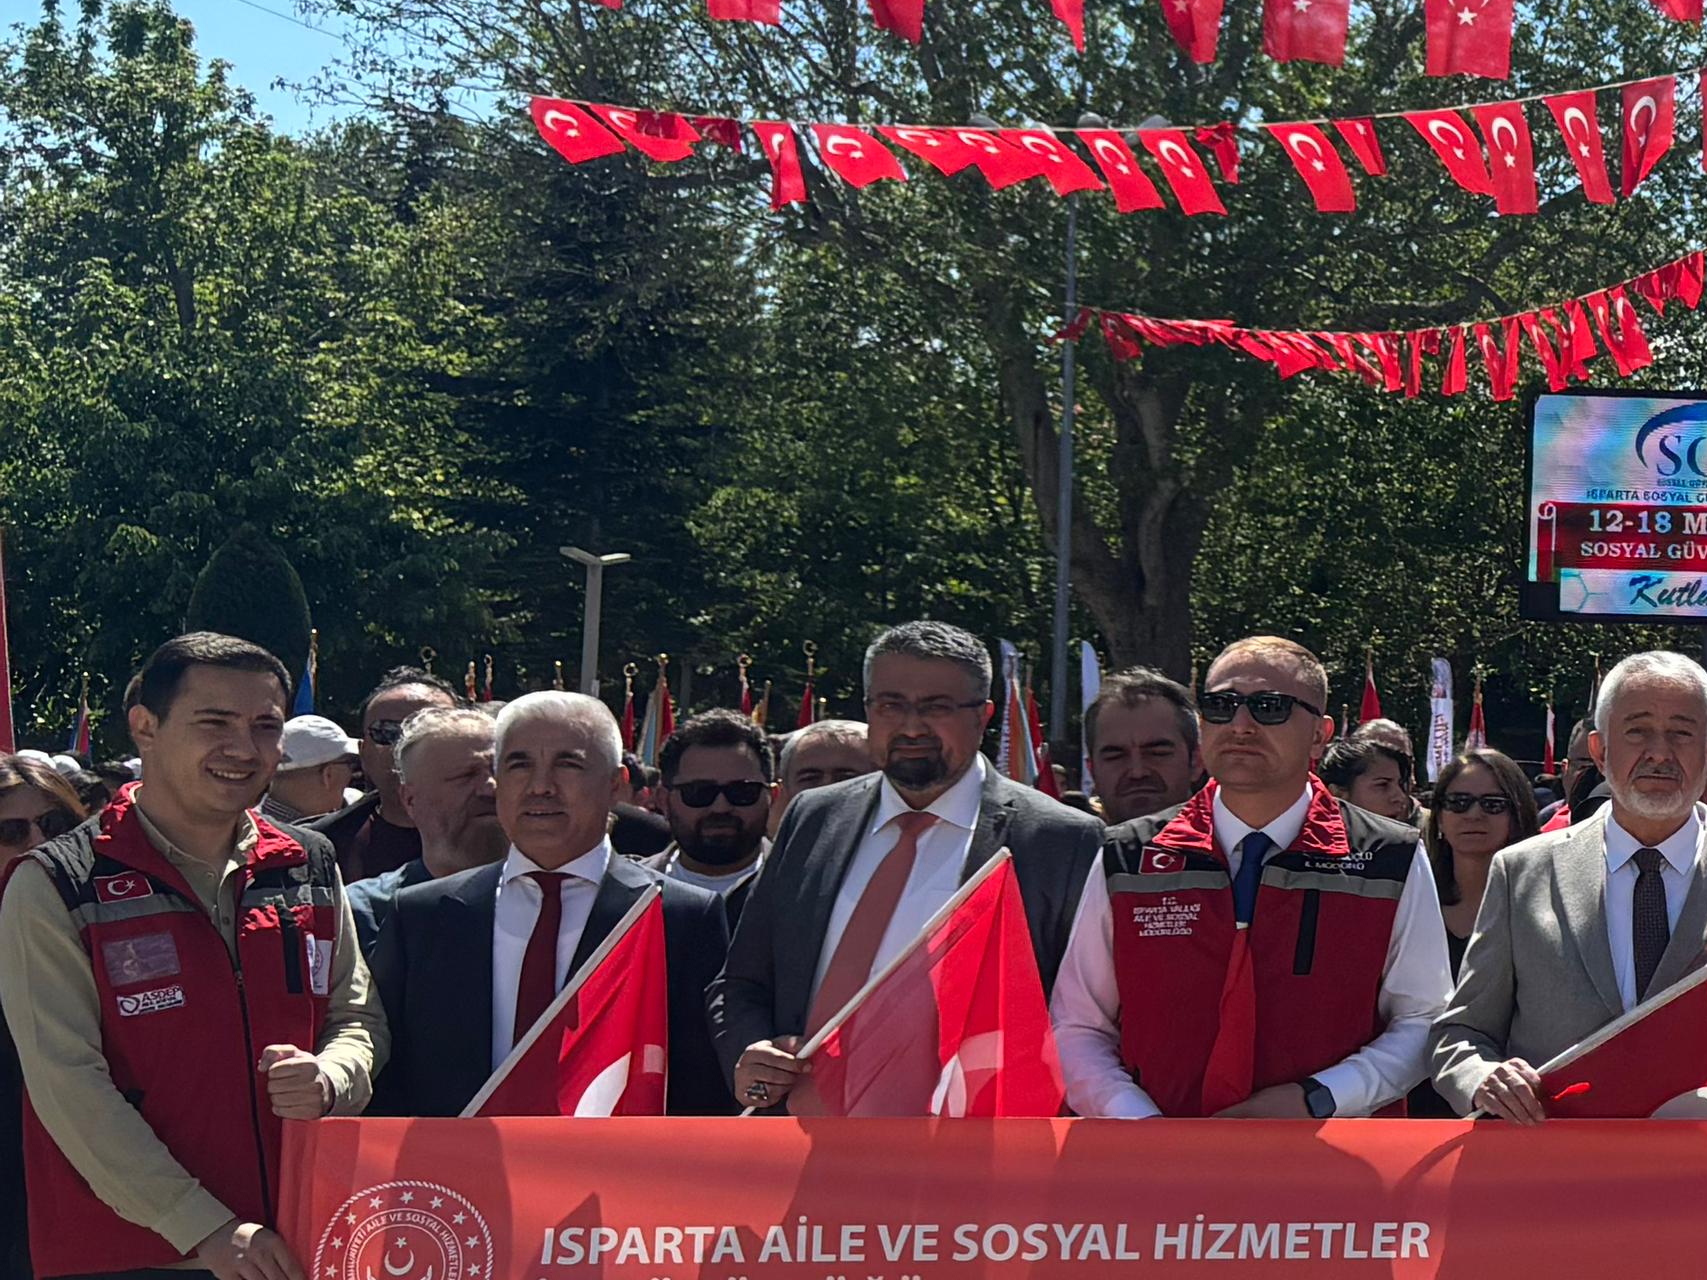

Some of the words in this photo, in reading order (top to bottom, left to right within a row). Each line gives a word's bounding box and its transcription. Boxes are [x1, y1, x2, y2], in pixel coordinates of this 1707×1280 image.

[1588, 509, 1672, 534] 12-18
[1580, 542, 1661, 559] SOSYAL
[541, 1224, 744, 1265] ISPARTA
[758, 1215, 866, 1264] AİLE
[879, 1223, 940, 1263] VE
[951, 1222, 1140, 1262] SOSYAL
[1153, 1213, 1431, 1260] HİZMETLER
